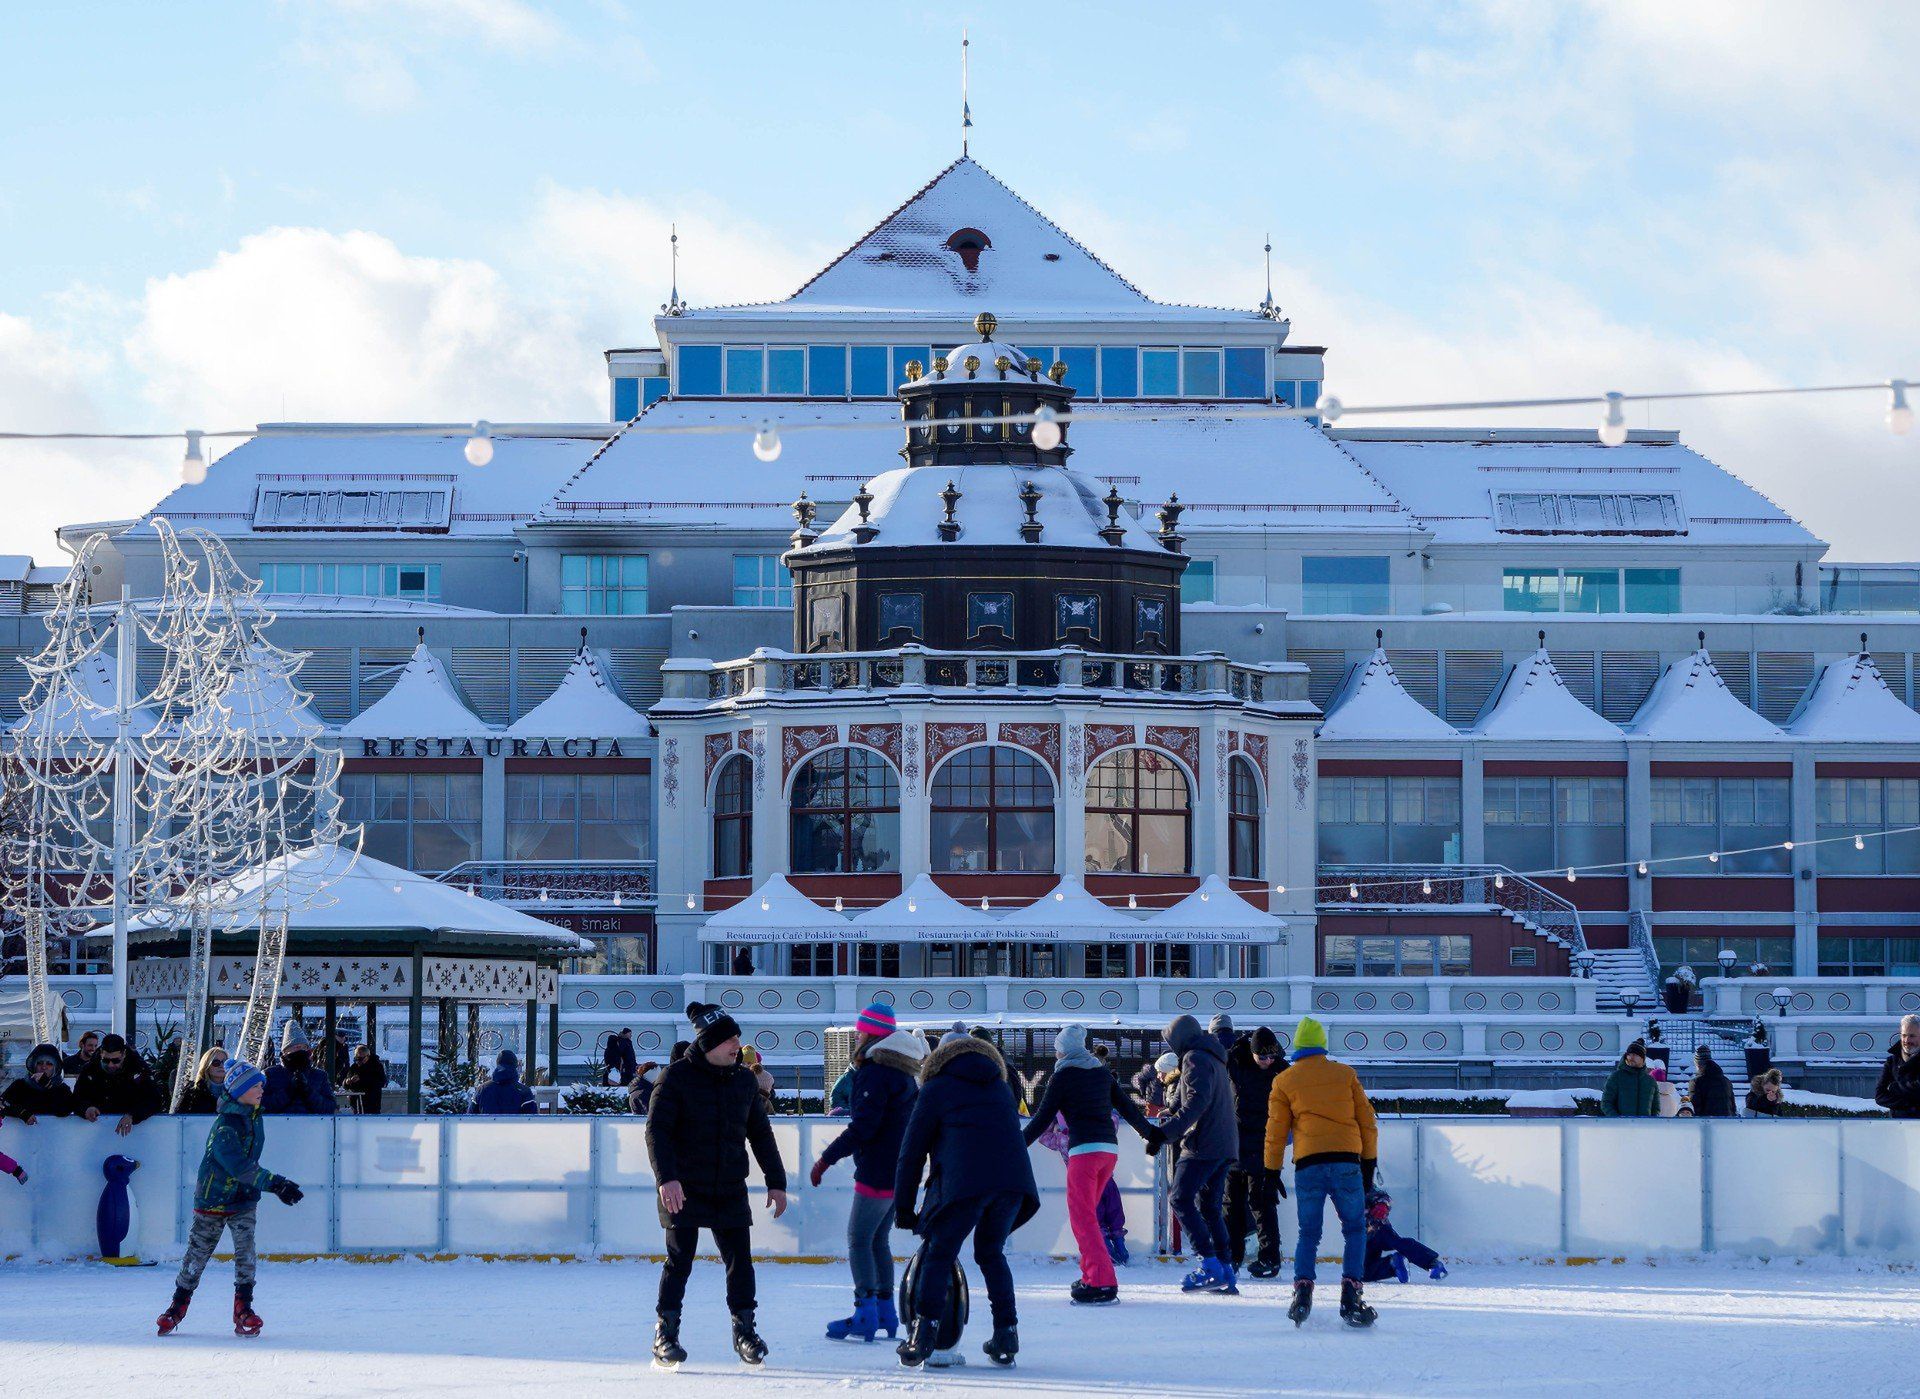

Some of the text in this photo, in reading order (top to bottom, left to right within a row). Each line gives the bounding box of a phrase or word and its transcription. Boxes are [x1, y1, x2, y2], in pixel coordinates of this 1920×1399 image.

[362, 737, 624, 757] RESTAURACJA
[726, 931, 780, 941] Restauracja
[804, 930, 837, 940] Polskie
[839, 930, 868, 939] Smaki
[918, 930, 972, 940] Restauracja
[995, 930, 1028, 939] Polskie
[1029, 930, 1059, 939] Smaki
[1109, 931, 1163, 940] Restauracja
[1187, 931, 1219, 940] Polskie
[1221, 931, 1250, 940] Smaki
